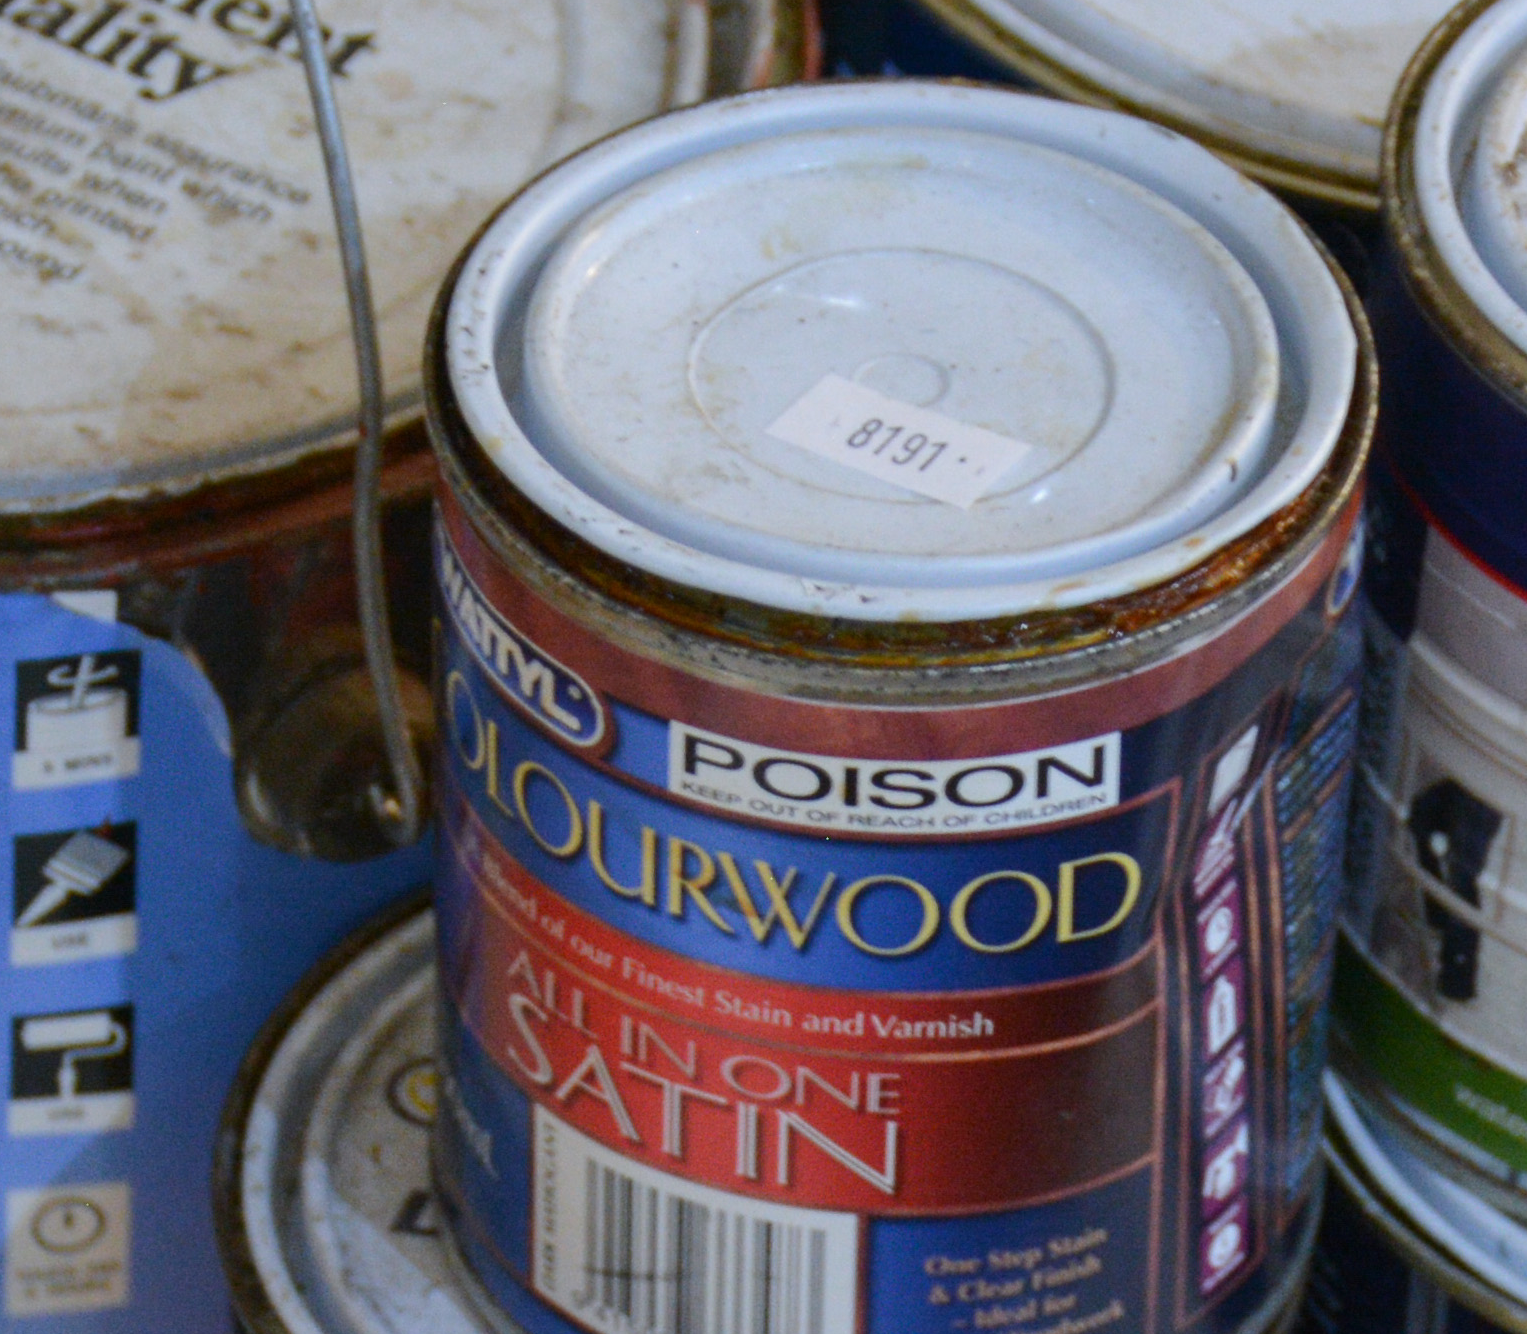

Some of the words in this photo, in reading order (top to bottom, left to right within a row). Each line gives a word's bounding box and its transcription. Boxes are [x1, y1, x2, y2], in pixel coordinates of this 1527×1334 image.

[845, 417, 950, 472] 8191
[442, 657, 1143, 957] OLOURWOOD
[680, 780, 742, 808] KEEP
[748, 797, 800, 818] OUT
[804, 807, 838, 825] OF
[846, 812, 937, 831] REACH
[943, 811, 977, 829] OF
[983, 791, 1109, 827] CHILDREN
[682, 733, 1107, 810] POISON
[507, 948, 600, 1041] ALL
[619, 1014, 698, 1080] IN
[720, 1053, 902, 1115] ONE
[621, 955, 709, 1007] Finest
[713, 989, 793, 1029] Stain
[802, 1007, 865, 1038] and
[870, 1012, 996, 1041] Varnish
[506, 992, 900, 1196] SATIN
